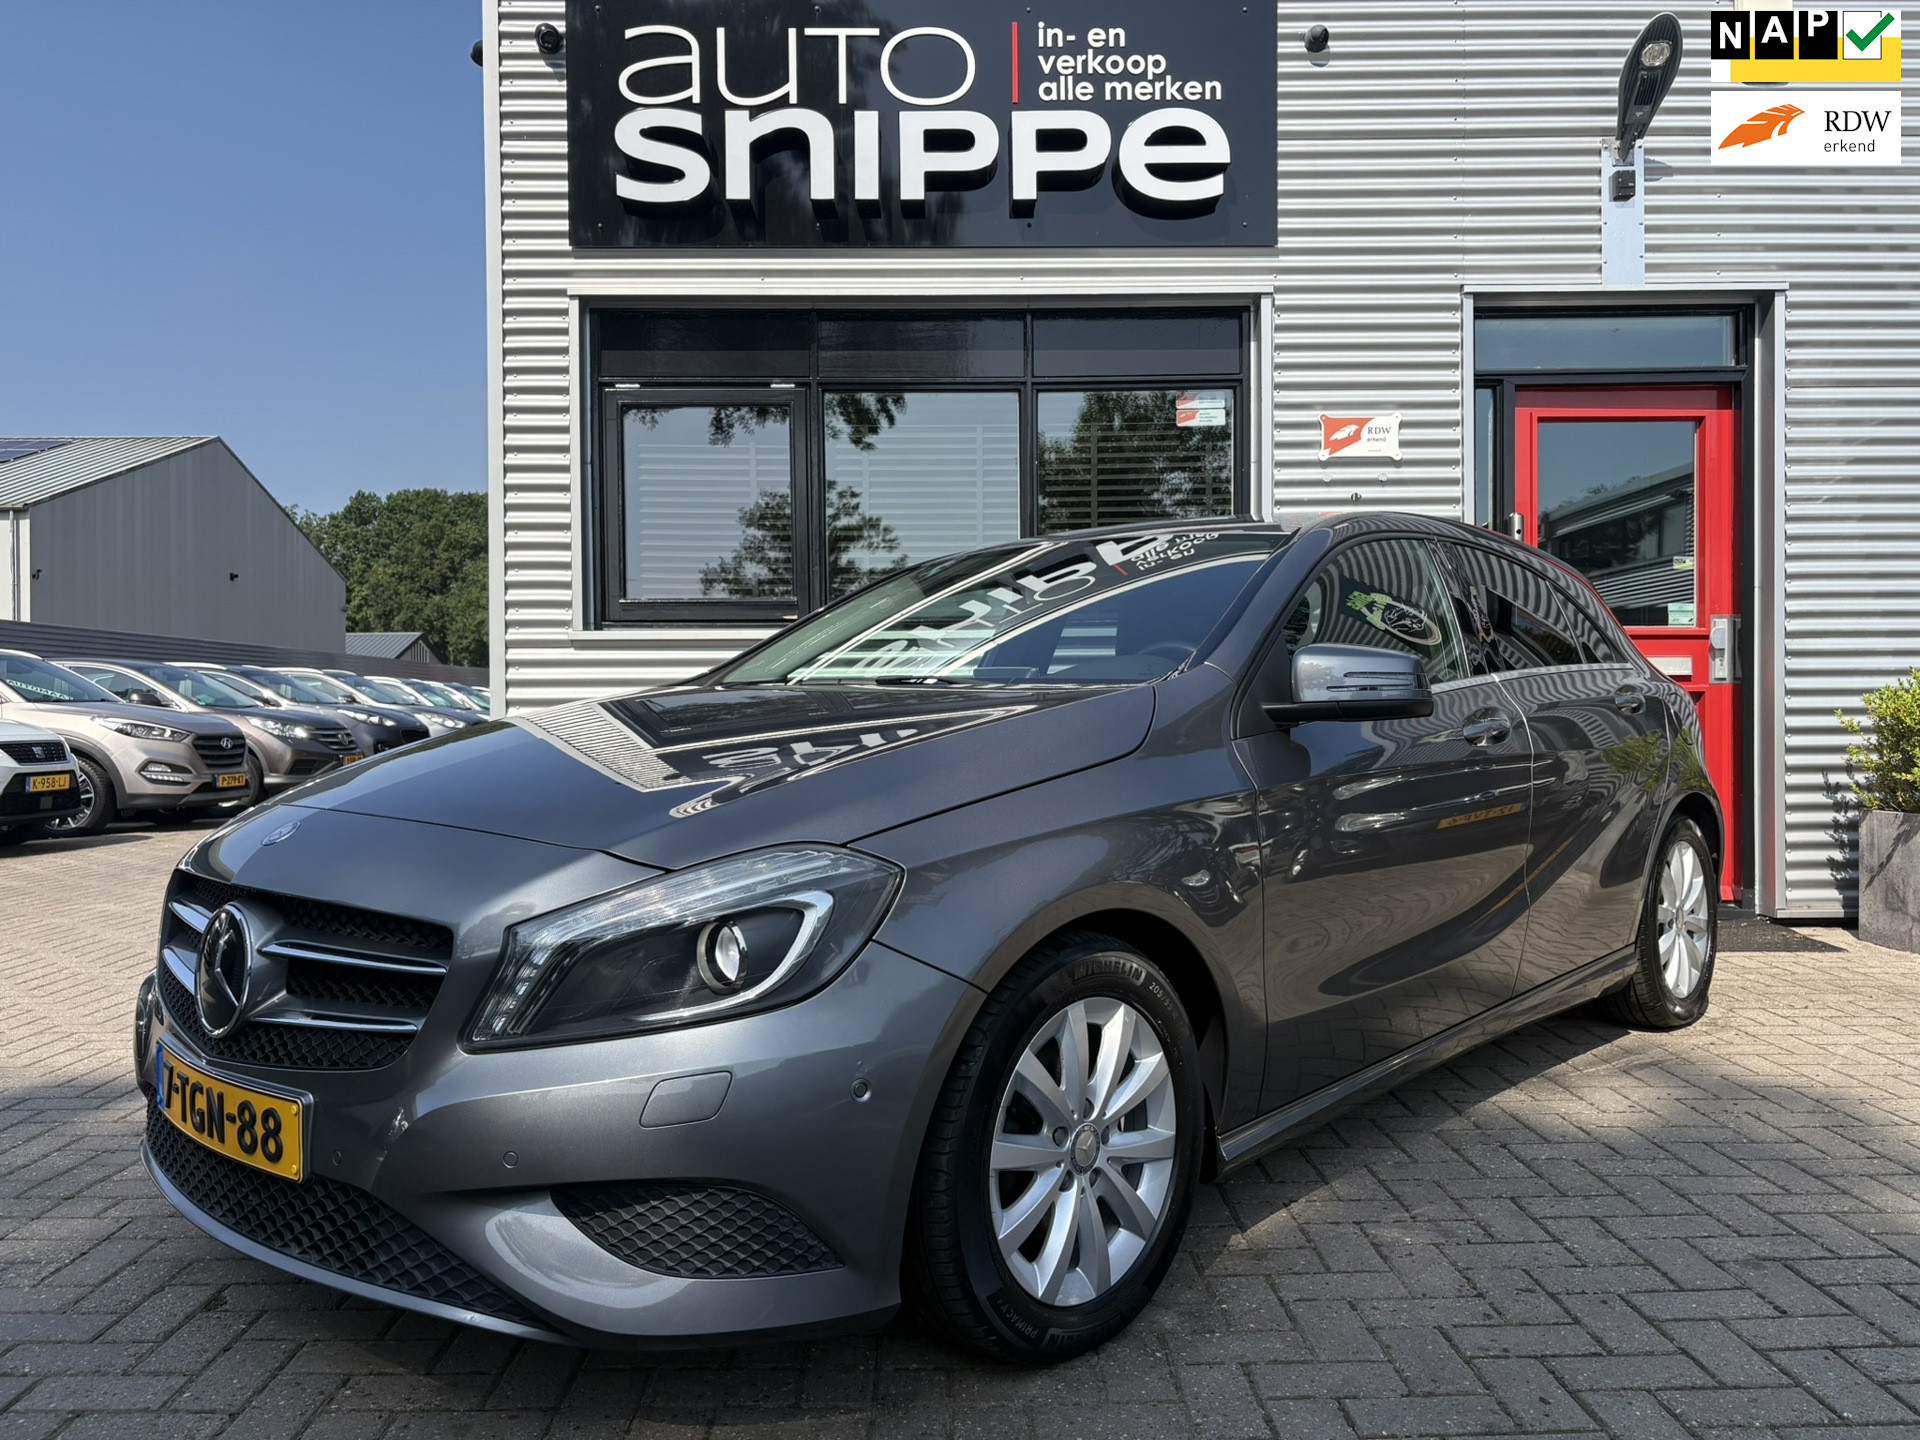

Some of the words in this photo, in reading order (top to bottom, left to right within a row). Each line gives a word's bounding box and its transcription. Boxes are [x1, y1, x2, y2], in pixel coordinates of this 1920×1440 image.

[1037, 21, 1076, 48] in-
[1087, 27, 1127, 48] en
[1037, 49, 1167, 82] verkoop
[1037, 76, 1096, 101] alle
[1104, 76, 1223, 101] merken
[1367, 426, 1392, 435] RDW
[32, 776, 67, 790] K-958-LJ
[163, 1060, 284, 1164] 7-TGN-88
[1000, 1303, 1039, 1339] PRIMACY
